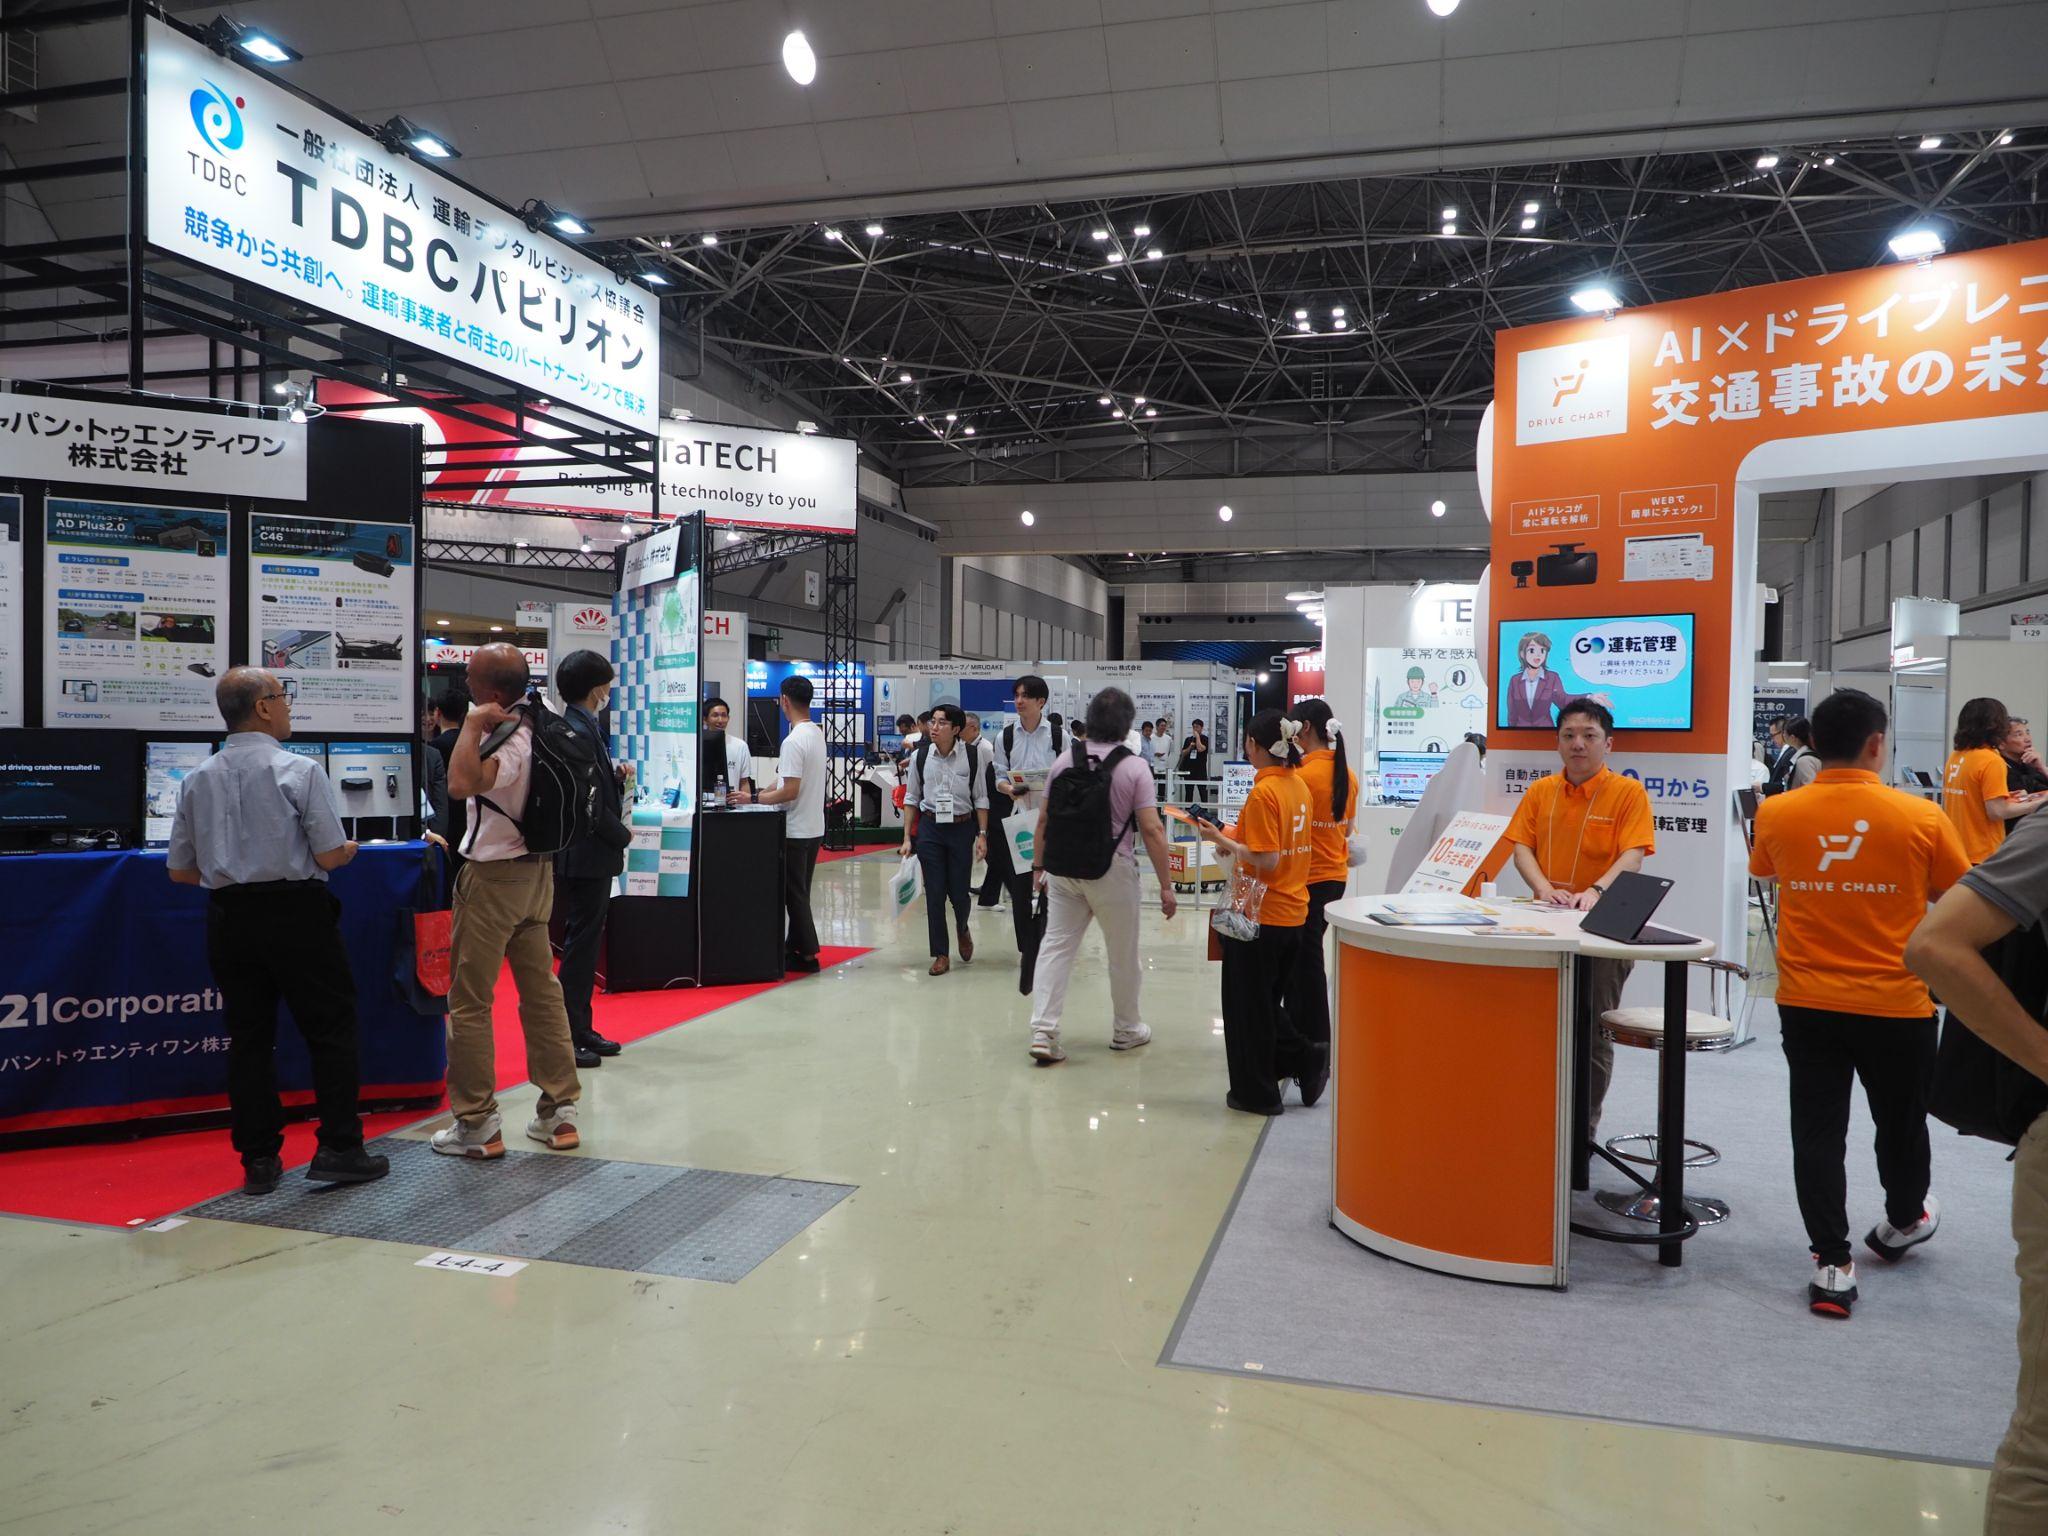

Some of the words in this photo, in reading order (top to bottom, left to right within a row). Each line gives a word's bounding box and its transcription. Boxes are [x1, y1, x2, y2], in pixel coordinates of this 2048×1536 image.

[187, 151, 247, 197] TDBC
[276, 160, 644, 371] TDBCパビリオン
[1650, 335, 2048, 430] 交通事故の未
[1528, 416, 1564, 428] DRIVE
[1569, 410, 1612, 423] CHART
[68, 442, 188, 476] 株式会社
[671, 483, 764, 507] technology
[768, 492, 784, 506] to
[788, 496, 816, 510] you
[1654, 495, 1690, 507] WEBで
[1528, 503, 1586, 518] AIドラレコが
[56, 519, 75, 529] AD
[78, 520, 126, 532] Plus2.0
[259, 532, 284, 542] C46
[527, 615, 543, 623] T-36
[2023, 629, 2041, 637] T-29
[1575, 637, 1606, 654] GO
[1608, 634, 1678, 654] 運転管理
[57, 711, 111, 720] Streamax
[8, 763, 33, 772] driving
[34, 763, 62, 771] crashes
[63, 763, 92, 771] resulted
[93, 763, 101, 771] in
[1653, 816, 1708, 834] 転管理
[1790, 880, 1835, 892] DRIVE
[1842, 882, 1897, 894] CHART
[435, 1256, 505, 1273] L4-4
